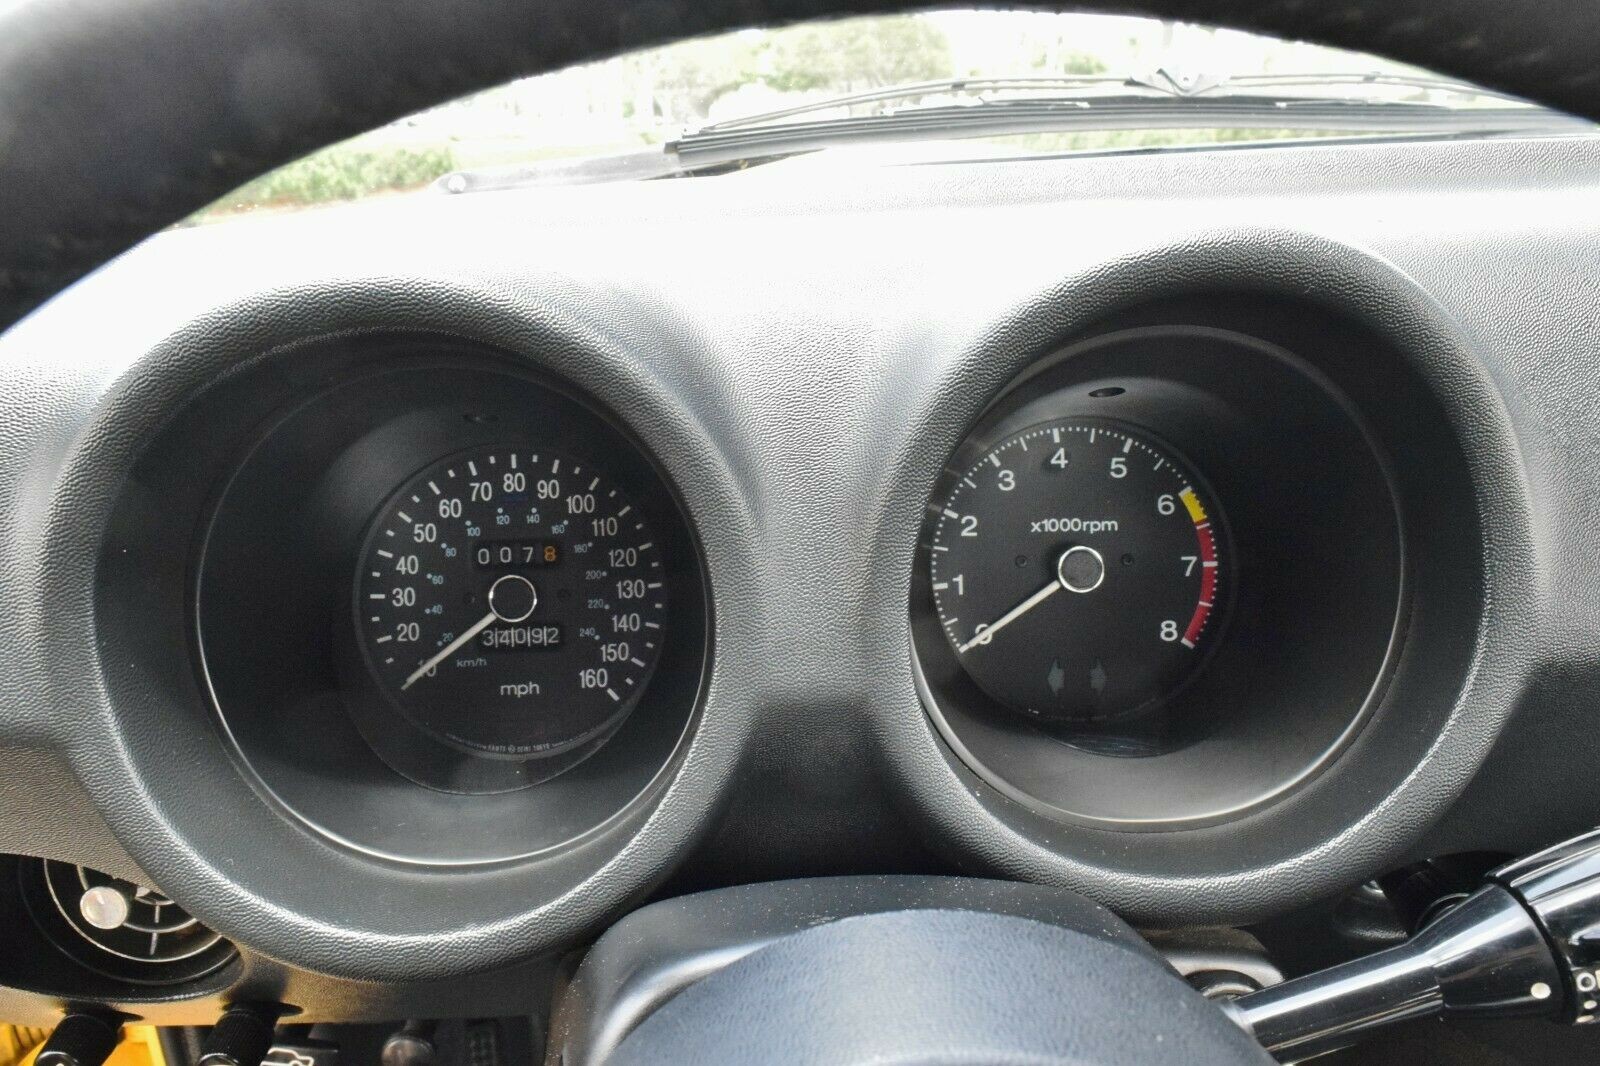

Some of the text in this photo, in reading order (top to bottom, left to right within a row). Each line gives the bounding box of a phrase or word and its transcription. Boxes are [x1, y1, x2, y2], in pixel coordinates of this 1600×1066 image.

[1050, 448, 1068, 468] 4
[1110, 458, 1127, 478] 5
[503, 473, 526, 492] 80
[537, 480, 559, 498] 90
[998, 470, 1016, 491] 3
[470, 482, 492, 501] 70
[439, 499, 462, 518] 60
[566, 494, 594, 513] 100
[1157, 494, 1175, 515] 6
[496, 515, 510, 524] 120
[526, 514, 540, 524] 140
[592, 517, 618, 536] 110
[960, 516, 978, 536] 2
[414, 524, 436, 542] 50
[467, 526, 480, 536] 100
[552, 525, 565, 534] 160
[396, 556, 418, 574] 40
[608, 548, 637, 567] 120
[1181, 556, 1197, 577] 7
[432, 576, 443, 585] 60
[616, 580, 645, 598] 130
[952, 574, 964, 596] 1
[392, 588, 415, 606] 30
[432, 605, 442, 614] 40
[397, 623, 419, 641] 20
[612, 613, 640, 632] 140
[1160, 620, 1178, 642] 8
[600, 643, 629, 662] 150
[456, 658, 487, 668] km/h
[580, 668, 608, 688] 160
[500, 681, 540, 697] mph
